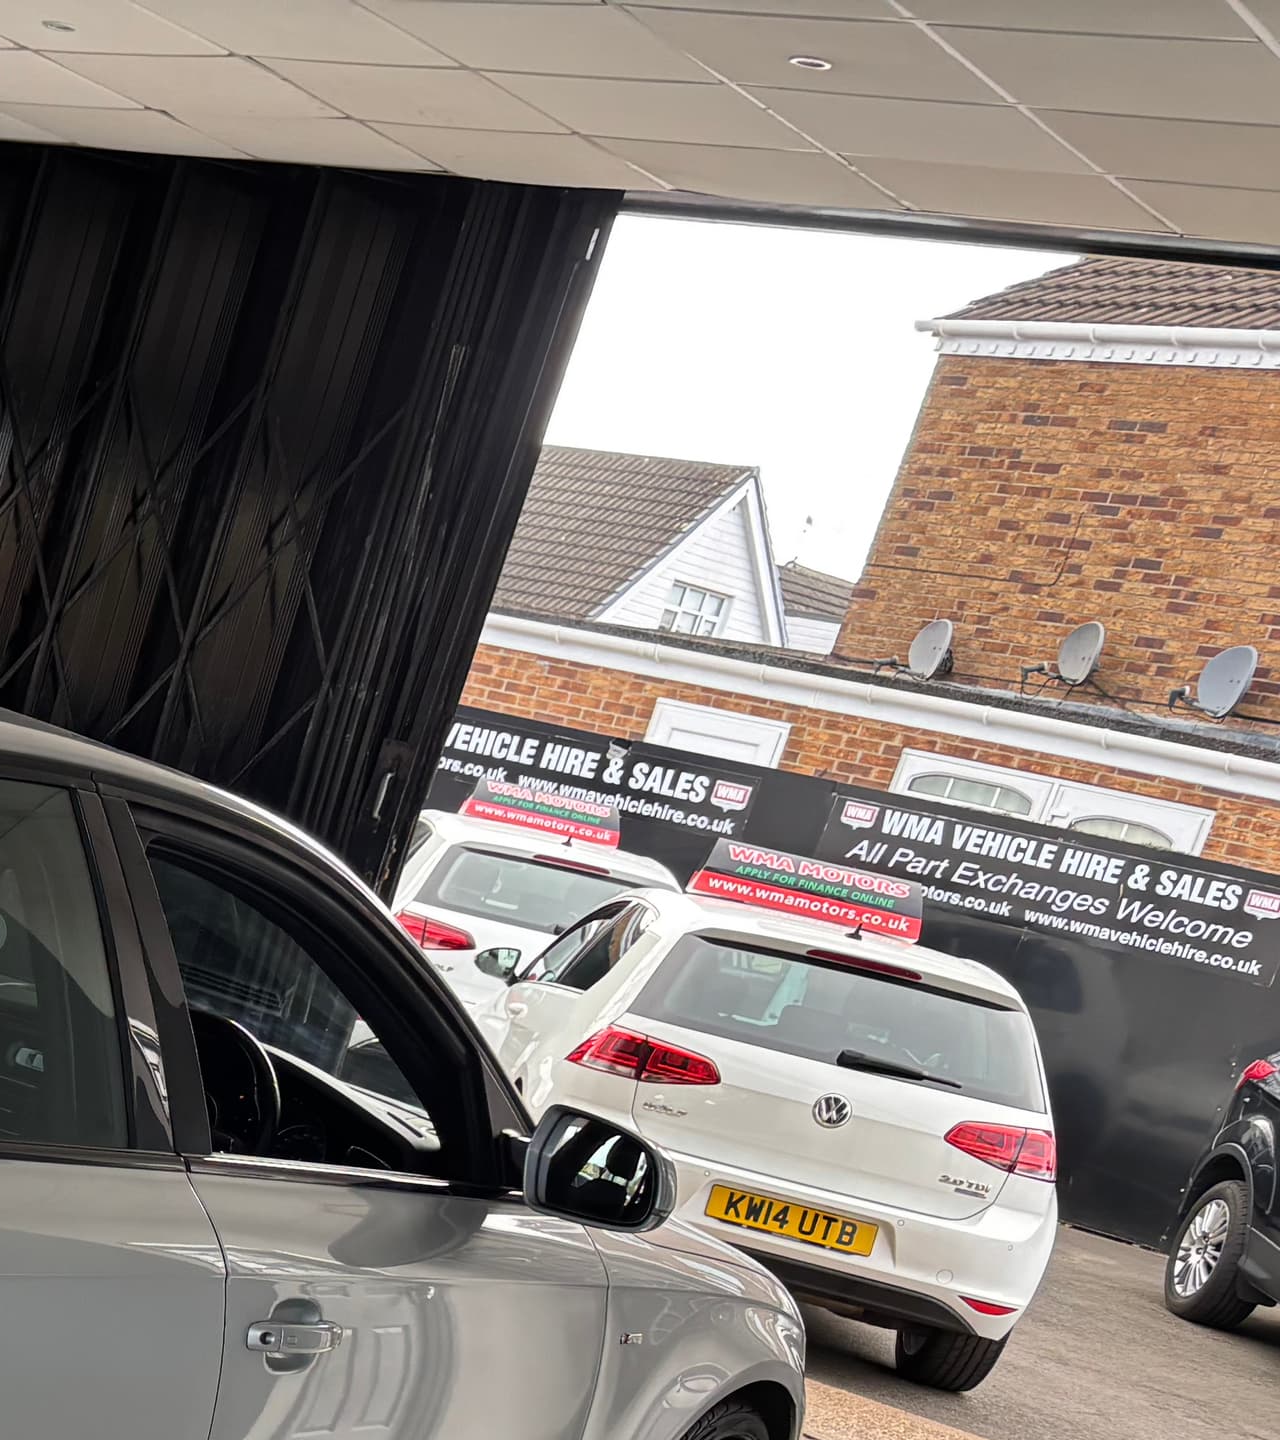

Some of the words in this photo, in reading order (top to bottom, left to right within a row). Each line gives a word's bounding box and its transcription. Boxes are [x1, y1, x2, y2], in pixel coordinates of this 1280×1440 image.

[487, 780, 533, 801] WMA
[535, 791, 611, 817] MOTORS
[539, 742, 601, 779] HIRE
[602, 757, 625, 786] &
[628, 761, 710, 804] SALES
[474, 803, 612, 841] www.wmamotors.co.uk
[535, 804, 570, 818] FINANCE
[570, 811, 602, 825] ONLINE
[728, 844, 795, 873] WMA
[798, 861, 911, 898] MOTORS
[735, 865, 771, 881] APPLY
[771, 871, 797, 886] FOR
[798, 878, 849, 898] FINANCE
[851, 890, 896, 909] ONLINE
[881, 808, 945, 846] WMA
[950, 823, 1059, 870] VEHICLE
[1058, 847, 1126, 884] HIRE
[1127, 864, 1151, 891] &
[1155, 869, 1243, 912] SALES
[708, 876, 911, 932] www.wmamotors.co.uk
[844, 839, 889, 865] All
[888, 847, 950, 879] Part
[950, 861, 1110, 915] Exchanges
[1115, 897, 1254, 949] Welcome
[1023, 908, 1264, 977] www.wmavehiclehire.co.uk
[723, 1191, 791, 1230] KW14
[798, 1209, 858, 1247] UTB
